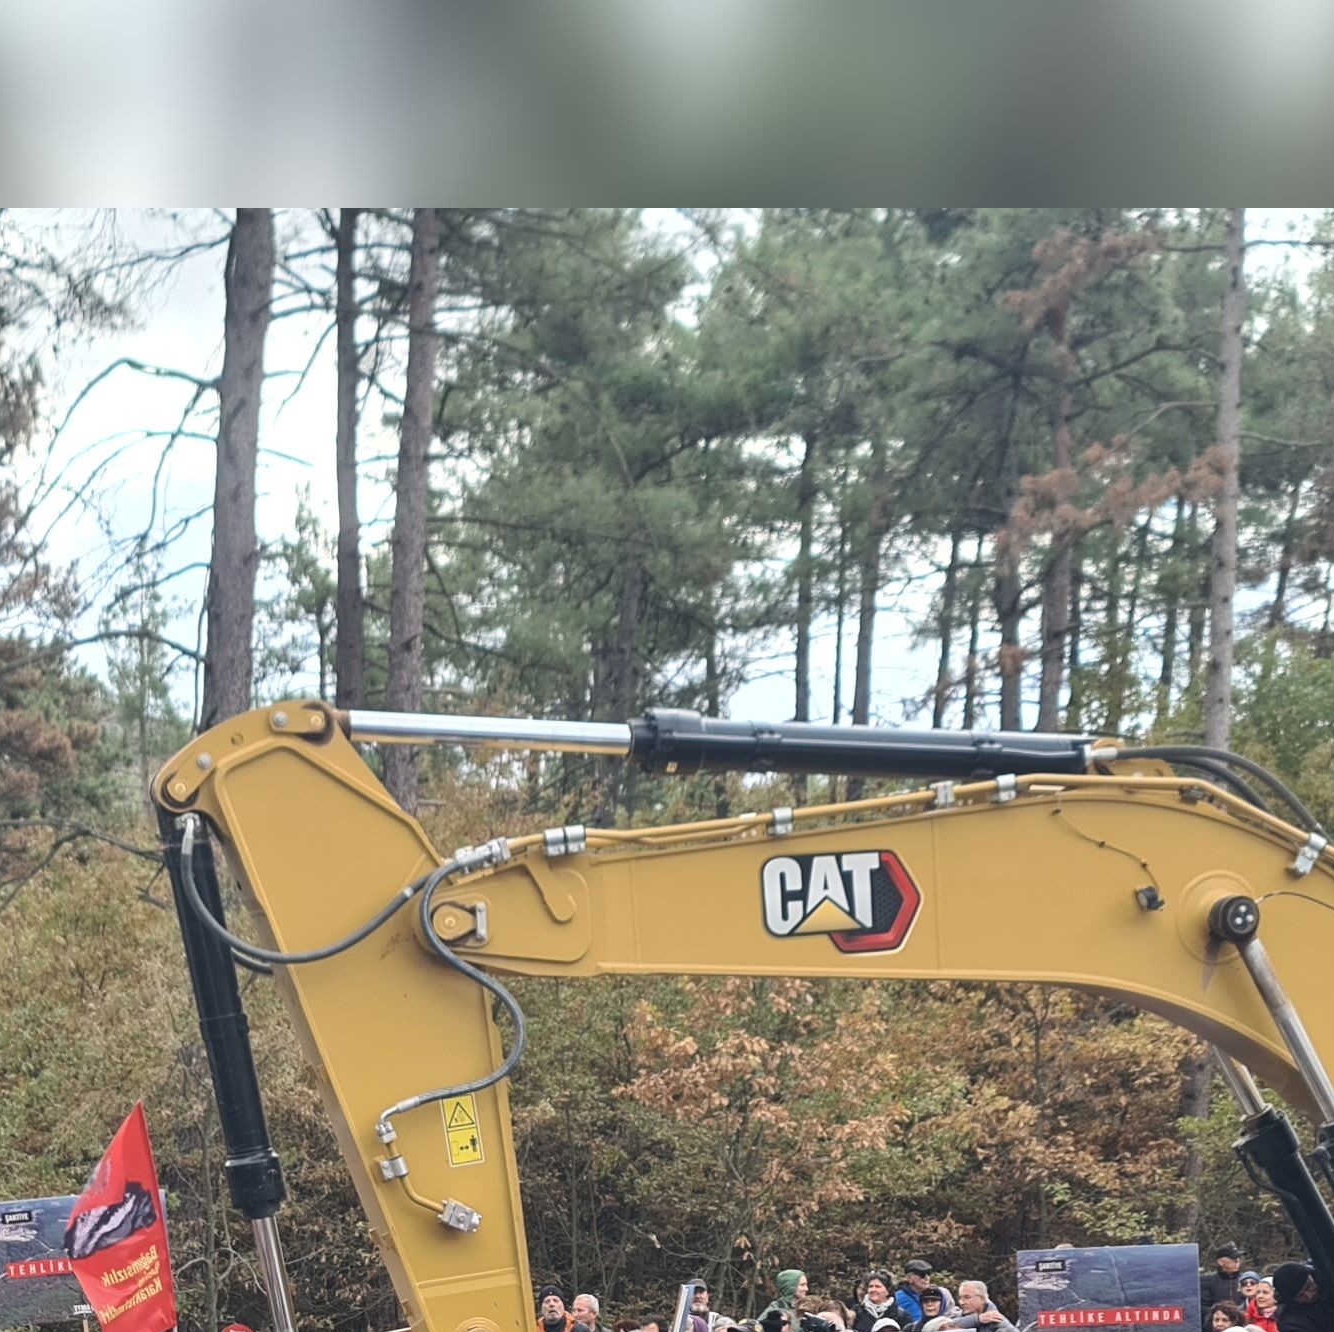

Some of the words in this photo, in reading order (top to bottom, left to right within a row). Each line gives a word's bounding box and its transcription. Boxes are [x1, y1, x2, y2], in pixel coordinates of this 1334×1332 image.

[763, 852, 880, 935] CAT
[1040, 1311, 1105, 1325] TEHLİKE
[1115, 1309, 1182, 1323] ALTINDA
